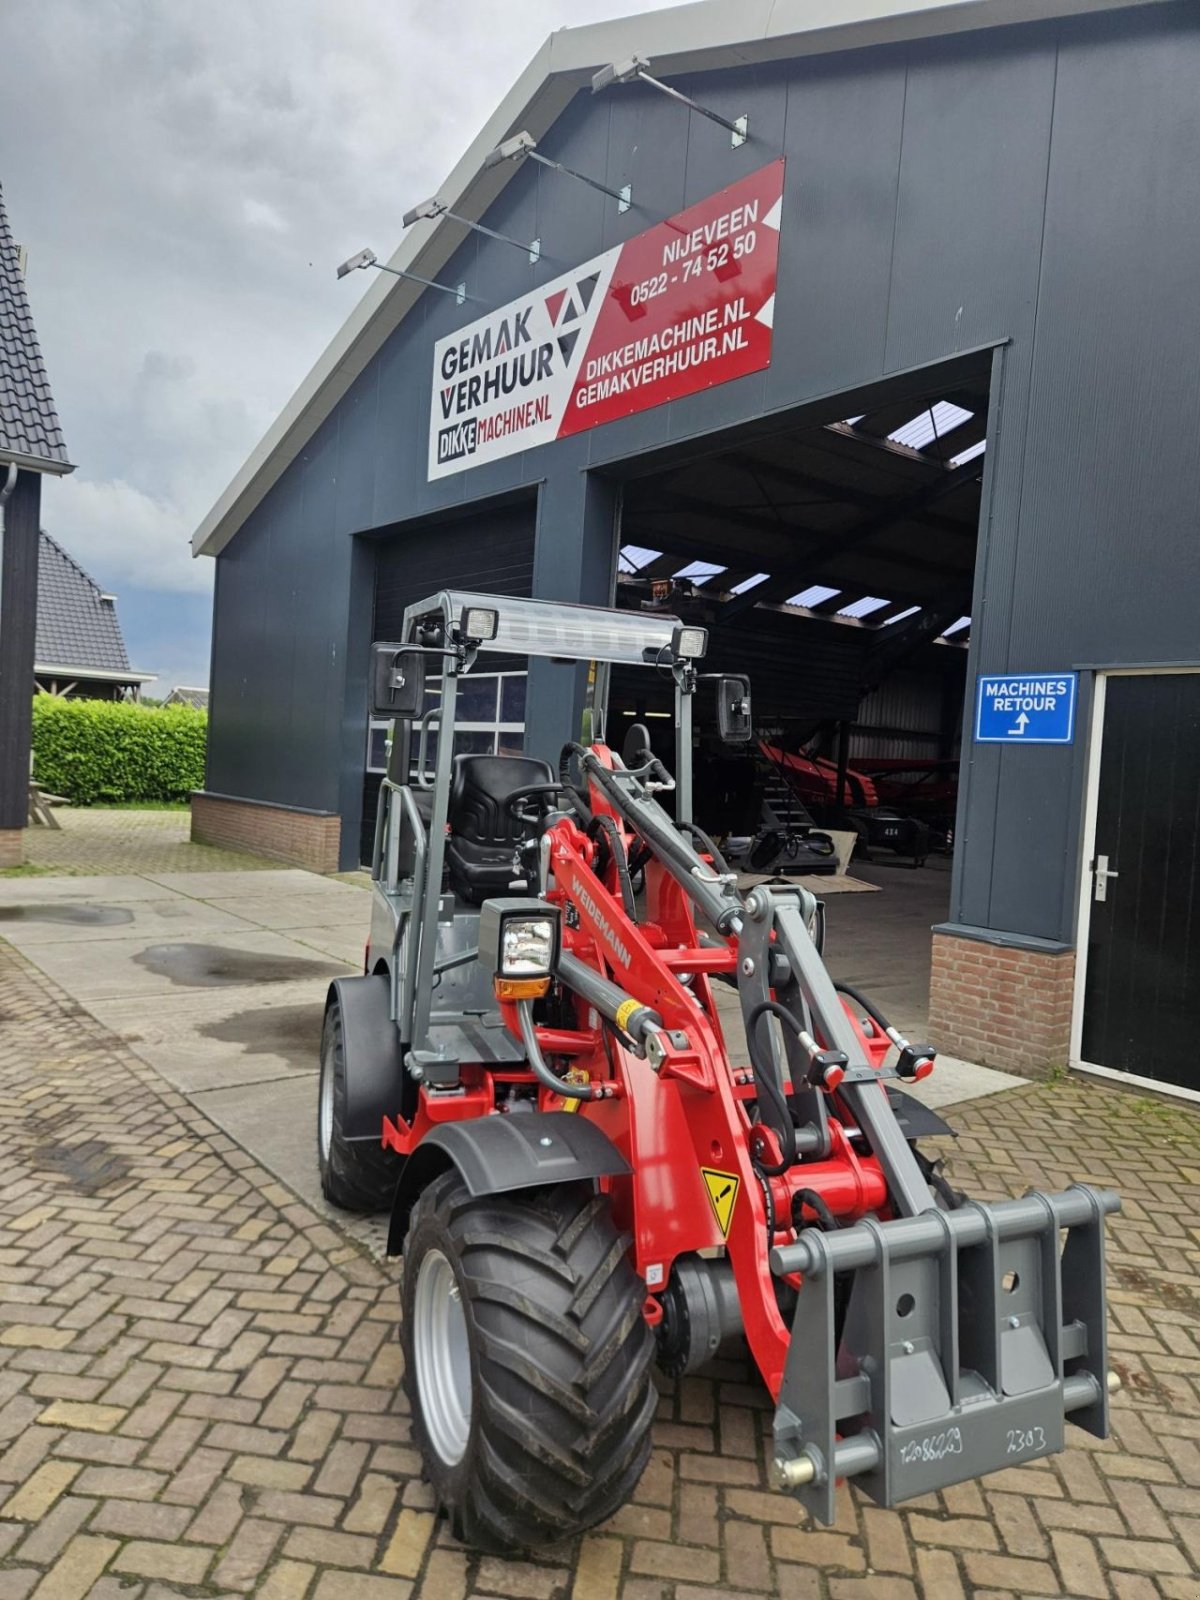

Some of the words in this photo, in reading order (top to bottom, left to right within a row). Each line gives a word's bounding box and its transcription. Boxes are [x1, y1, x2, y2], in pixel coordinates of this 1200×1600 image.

[630, 271, 668, 307] 0522
[682, 254, 703, 284] 74
[706, 243, 729, 272] 52
[732, 229, 757, 260] 50
[661, 199, 759, 267] NIJEVEEN
[440, 305, 534, 381] GEMAK
[575, 326, 749, 409] GEMAKVERHUUR.NL
[585, 296, 751, 382] DIKKEMACHINE.NL
[439, 341, 554, 420] VERHUUR
[985, 681, 1067, 697] MACHINES
[993, 697, 1056, 711] RETOUR
[572, 874, 632, 971] WEIDEMANN
[1006, 1426, 1047, 1453] 2303
